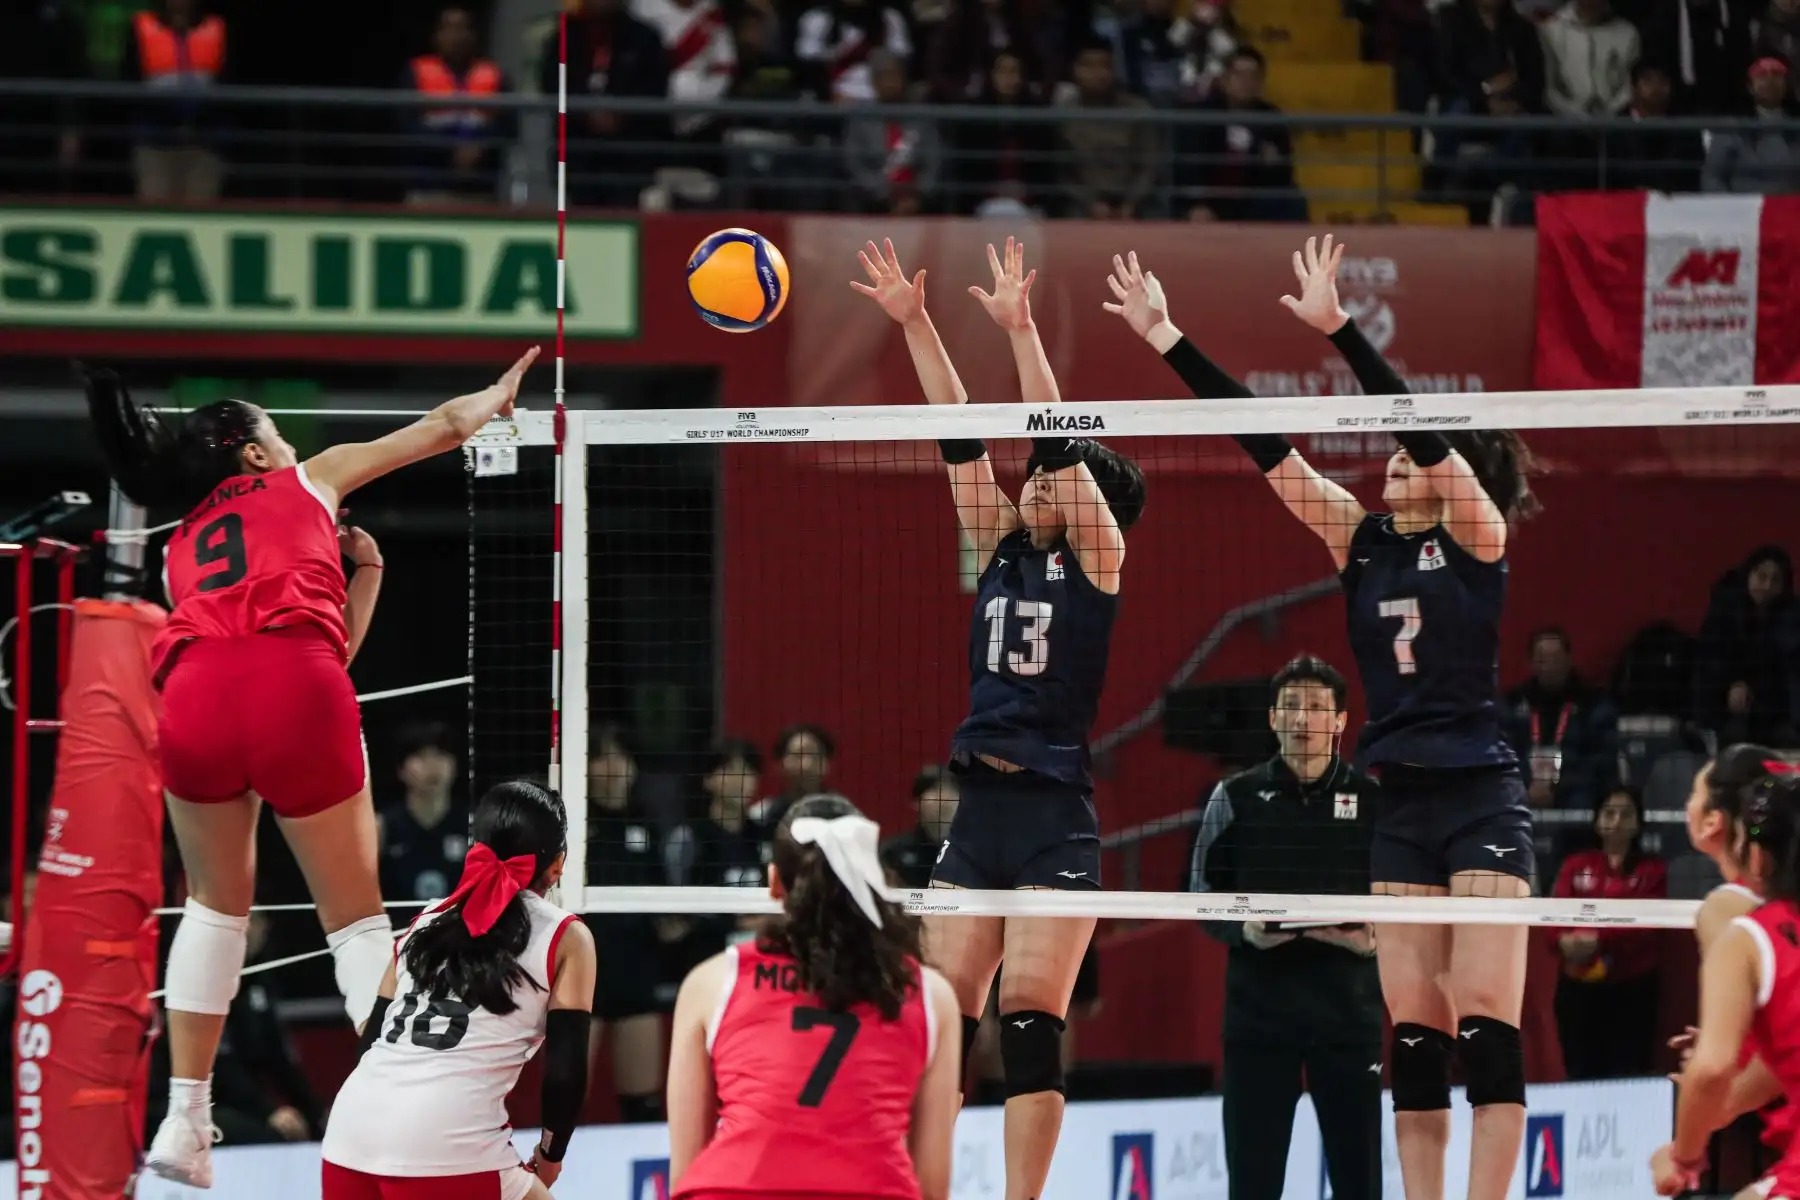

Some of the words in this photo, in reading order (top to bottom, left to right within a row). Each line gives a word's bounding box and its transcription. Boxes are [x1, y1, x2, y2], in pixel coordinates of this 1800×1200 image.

[2, 227, 577, 315] SALIDA
[686, 430, 708, 438] GIRLS'
[710, 430, 724, 438] U17
[727, 429, 752, 437] WORLD
[754, 428, 809, 437] CHAMPIONSHIP
[738, 412, 756, 420] FIVB
[195, 512, 248, 593] 9
[984, 596, 1053, 676] 13
[1377, 597, 1422, 675] 7
[791, 1005, 861, 1108] 7
[1575, 1112, 1626, 1160] APL
